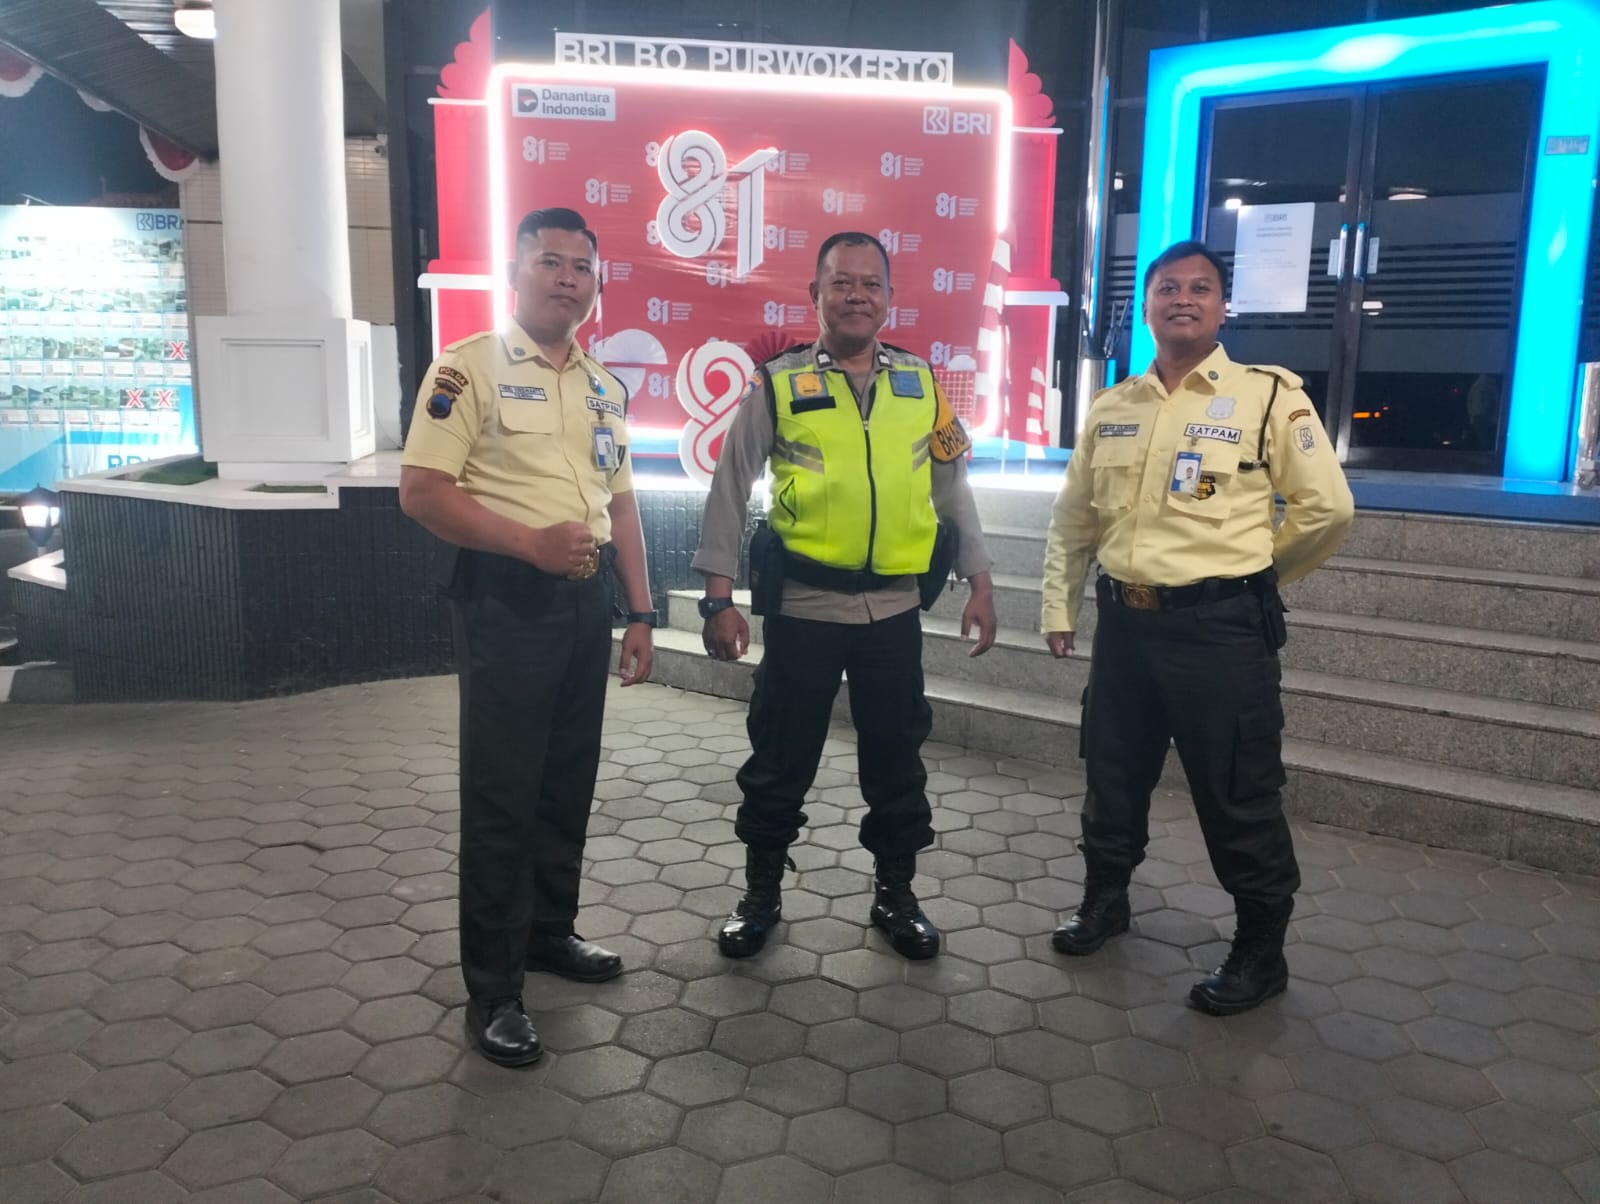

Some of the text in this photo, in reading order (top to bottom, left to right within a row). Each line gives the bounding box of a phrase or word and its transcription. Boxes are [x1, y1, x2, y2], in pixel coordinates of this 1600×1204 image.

[563, 39, 947, 84] BRI BO PURWOKERTO
[541, 88, 611, 104] Danantara
[541, 103, 607, 117] Indonesia
[953, 112, 992, 135] BRI
[522, 135, 546, 165] 81
[880, 152, 903, 180] 81
[584, 178, 608, 207] 81
[656, 129, 779, 279] 81
[822, 188, 844, 216] 81
[935, 192, 958, 220] 81
[764, 225, 786, 252] 81
[705, 260, 728, 288] 81
[932, 267, 955, 295] 81
[647, 297, 670, 325] 81
[763, 300, 785, 328] 81
[648, 372, 671, 400] 81
[1188, 426, 1239, 441] SATPAM
